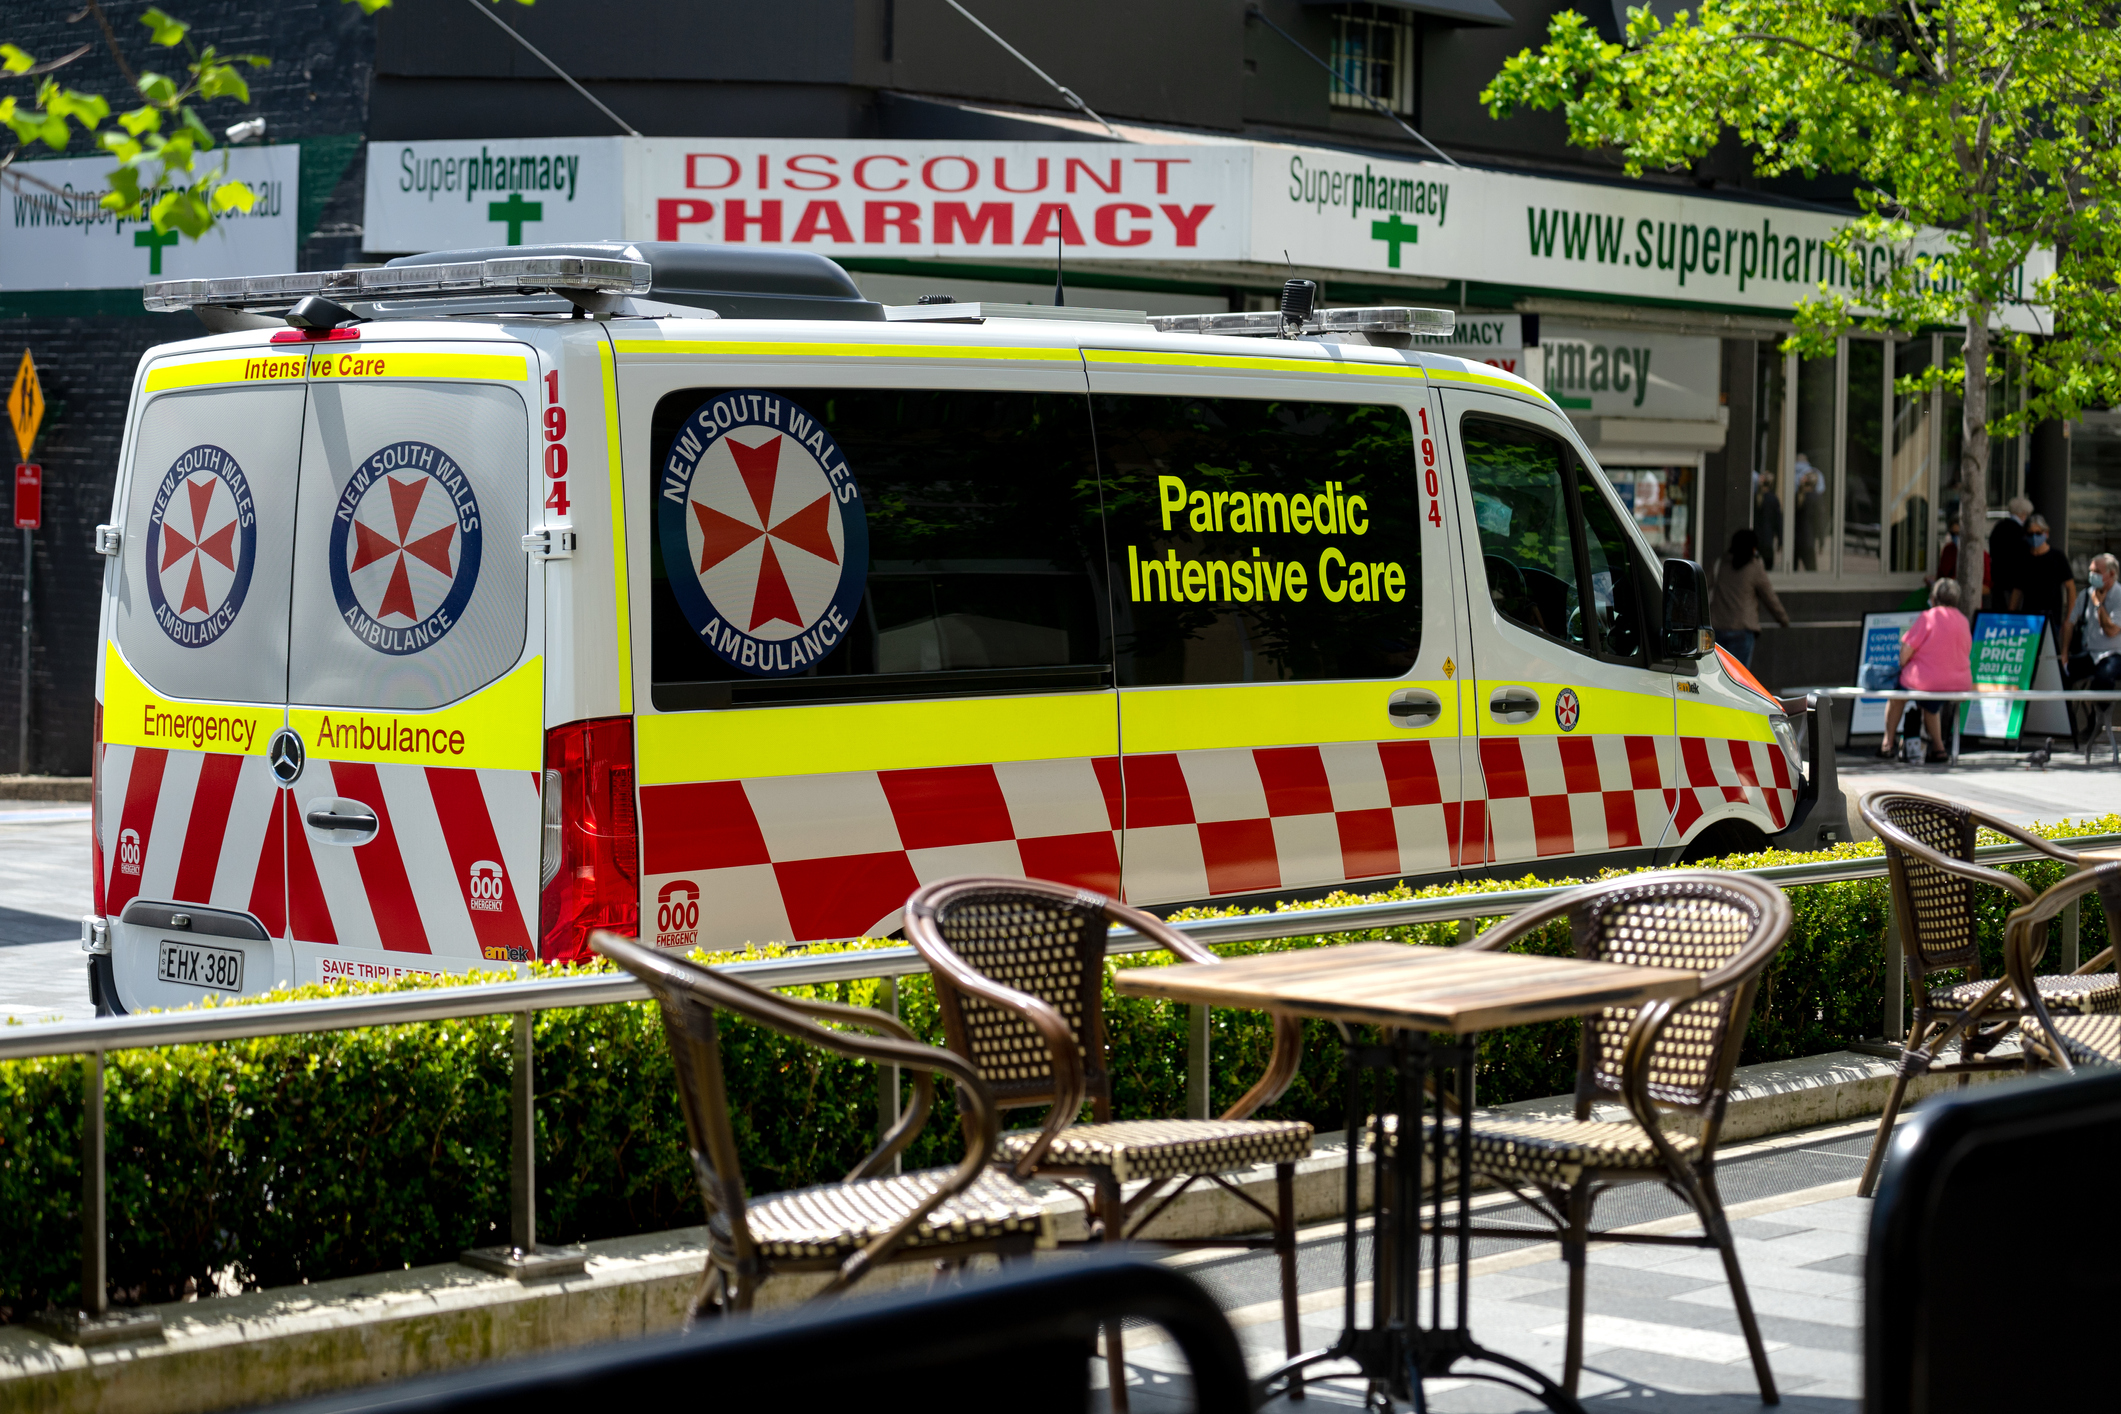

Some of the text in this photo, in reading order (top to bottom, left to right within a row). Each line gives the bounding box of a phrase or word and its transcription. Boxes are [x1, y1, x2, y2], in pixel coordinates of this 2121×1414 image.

[400, 146, 580, 202] Superpharmacy
[684, 153, 1191, 194] DISCOUNT
[1289, 155, 1450, 227] Superpharmacy
[656, 198, 1215, 248] PHARMACY
[244, 354, 386, 379] Intensive Care
[543, 369, 571, 516] 1904
[663, 394, 858, 505] NEW SOUTH WALES
[152, 448, 254, 528] NEW SOUTH WALES
[337, 445, 479, 533] NEW SOUTH WALES
[1418, 407, 1442, 528] 1904
[1157, 475, 1369, 536] Paramedic
[1127, 545, 1406, 603] Intensive Care
[156, 601, 236, 644] AMBULANCE
[344, 605, 453, 651] AMBULANCE
[700, 605, 849, 671] AMBULANCE
[1980, 647, 2026, 663] PRICE
[143, 705, 257, 752] Emergency
[317, 716, 466, 756] Ambulance
[470, 899, 503, 911] EMERGENCY
[484, 945, 530, 962] amtek
[656, 931, 699, 948] EMERGENCY
[322, 959, 355, 976] SAVE
